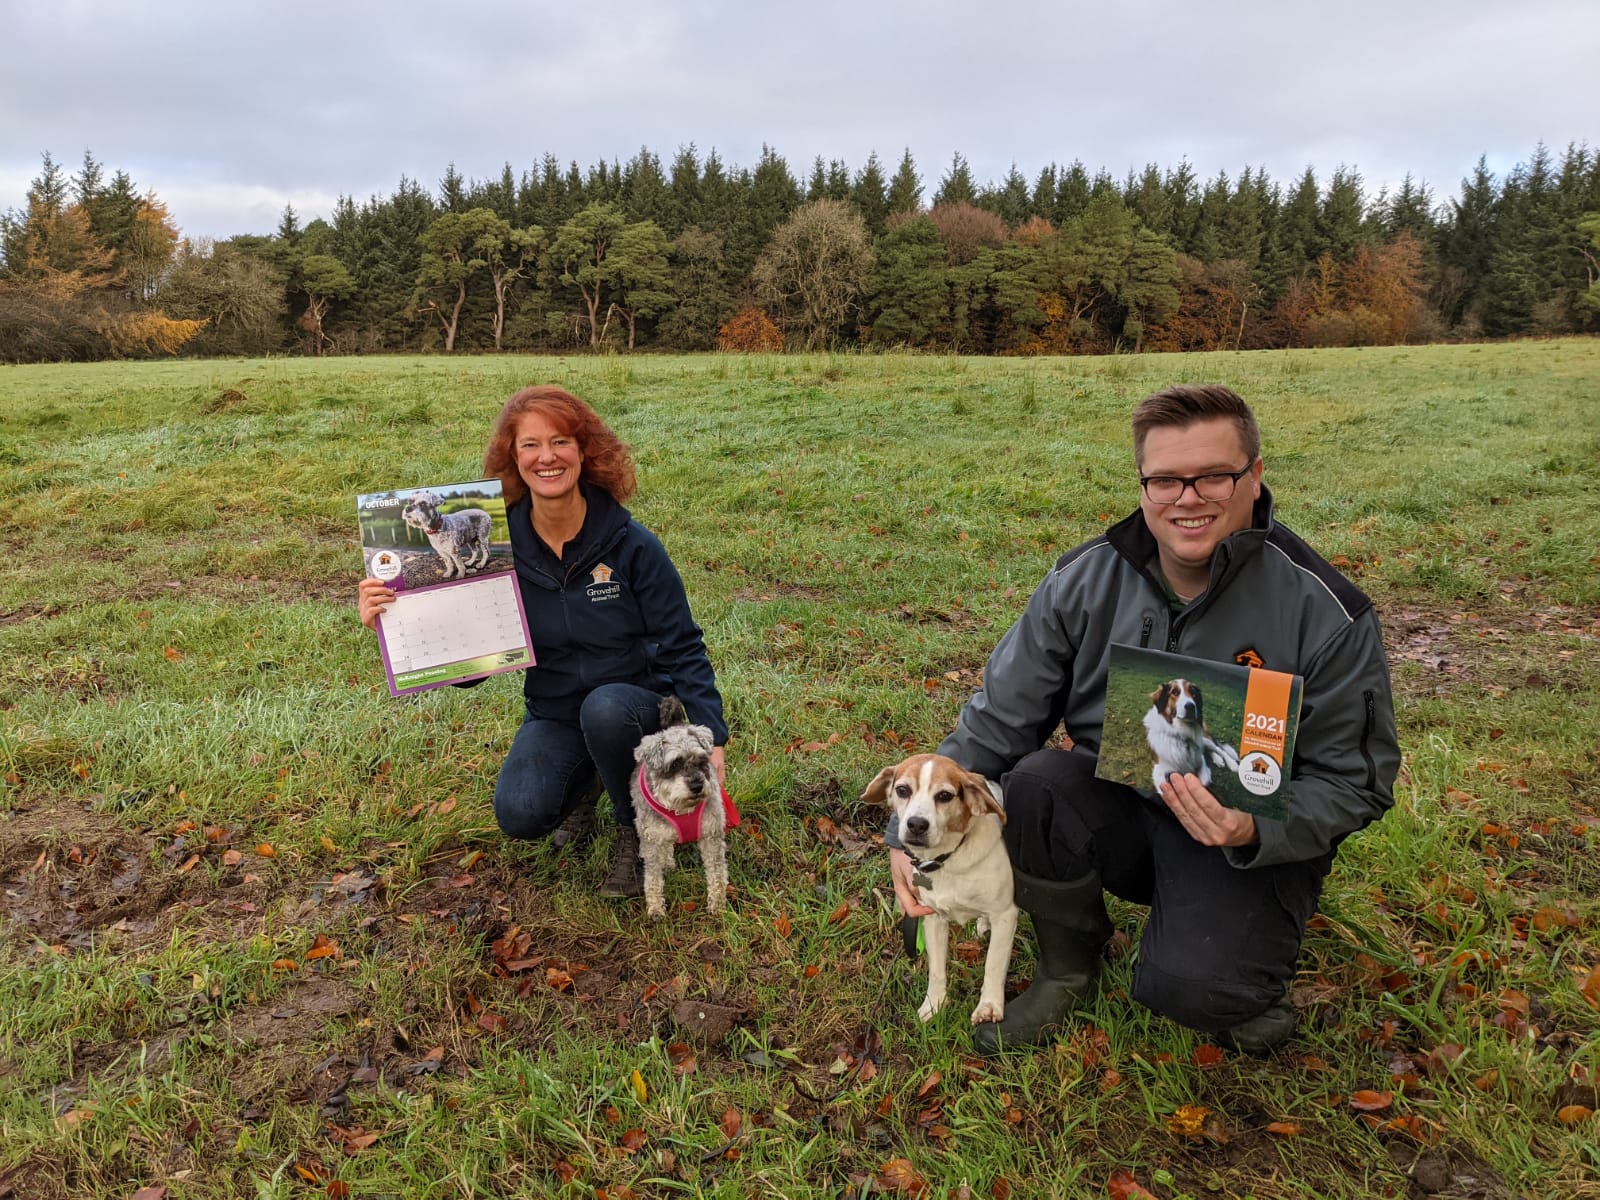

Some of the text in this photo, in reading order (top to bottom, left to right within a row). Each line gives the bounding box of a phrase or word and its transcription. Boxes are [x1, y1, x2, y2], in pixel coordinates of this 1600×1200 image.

[365, 498, 400, 509] OCTOBER
[586, 584, 620, 597] Grovehill
[1246, 713, 1284, 734] 2021
[1245, 729, 1283, 741] CALENDAR
[1244, 774, 1274, 786] Grovehill
